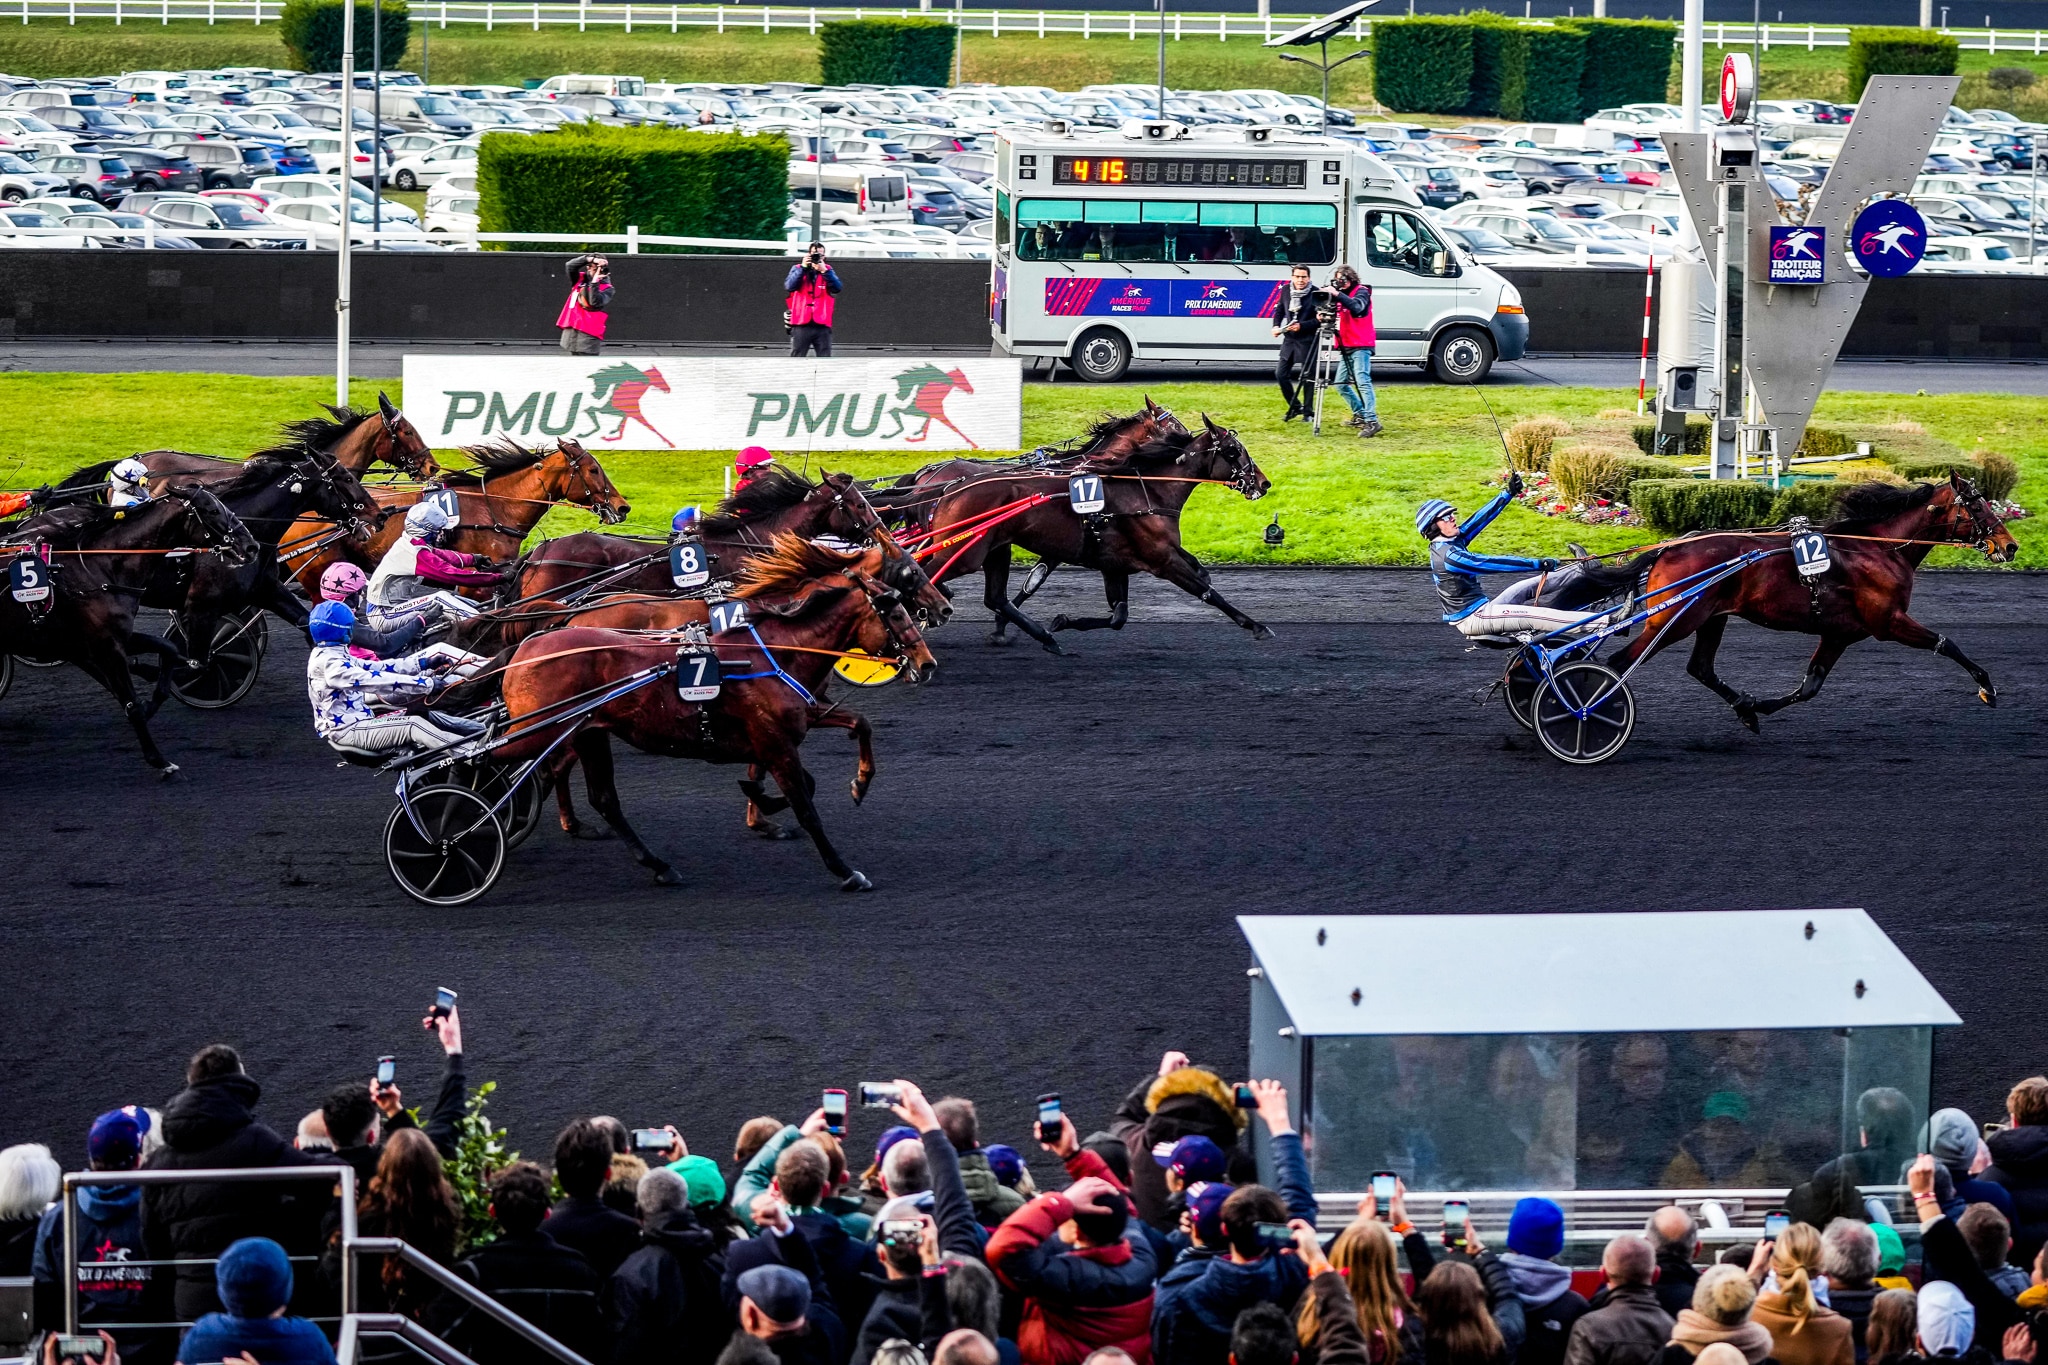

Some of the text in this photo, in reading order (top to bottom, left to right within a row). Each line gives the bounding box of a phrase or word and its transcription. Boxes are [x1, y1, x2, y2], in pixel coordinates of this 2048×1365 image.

[1074, 160, 1089, 181] 4
[1771, 259, 1822, 269] TROTTEUR
[1771, 269, 1822, 281] FRANÇAIS
[1109, 296, 1152, 305] AMÉRIQUE
[1184, 299, 1243, 309] PRIX D'AMÉRIQUE
[441, 390, 584, 436] PMU
[745, 392, 888, 438] PMU
[1072, 477, 1099, 502] 17
[679, 546, 699, 573] 8
[1795, 535, 1827, 563] 12
[20, 560, 39, 588] 5
[712, 603, 749, 633] 14
[689, 657, 707, 686] 7
